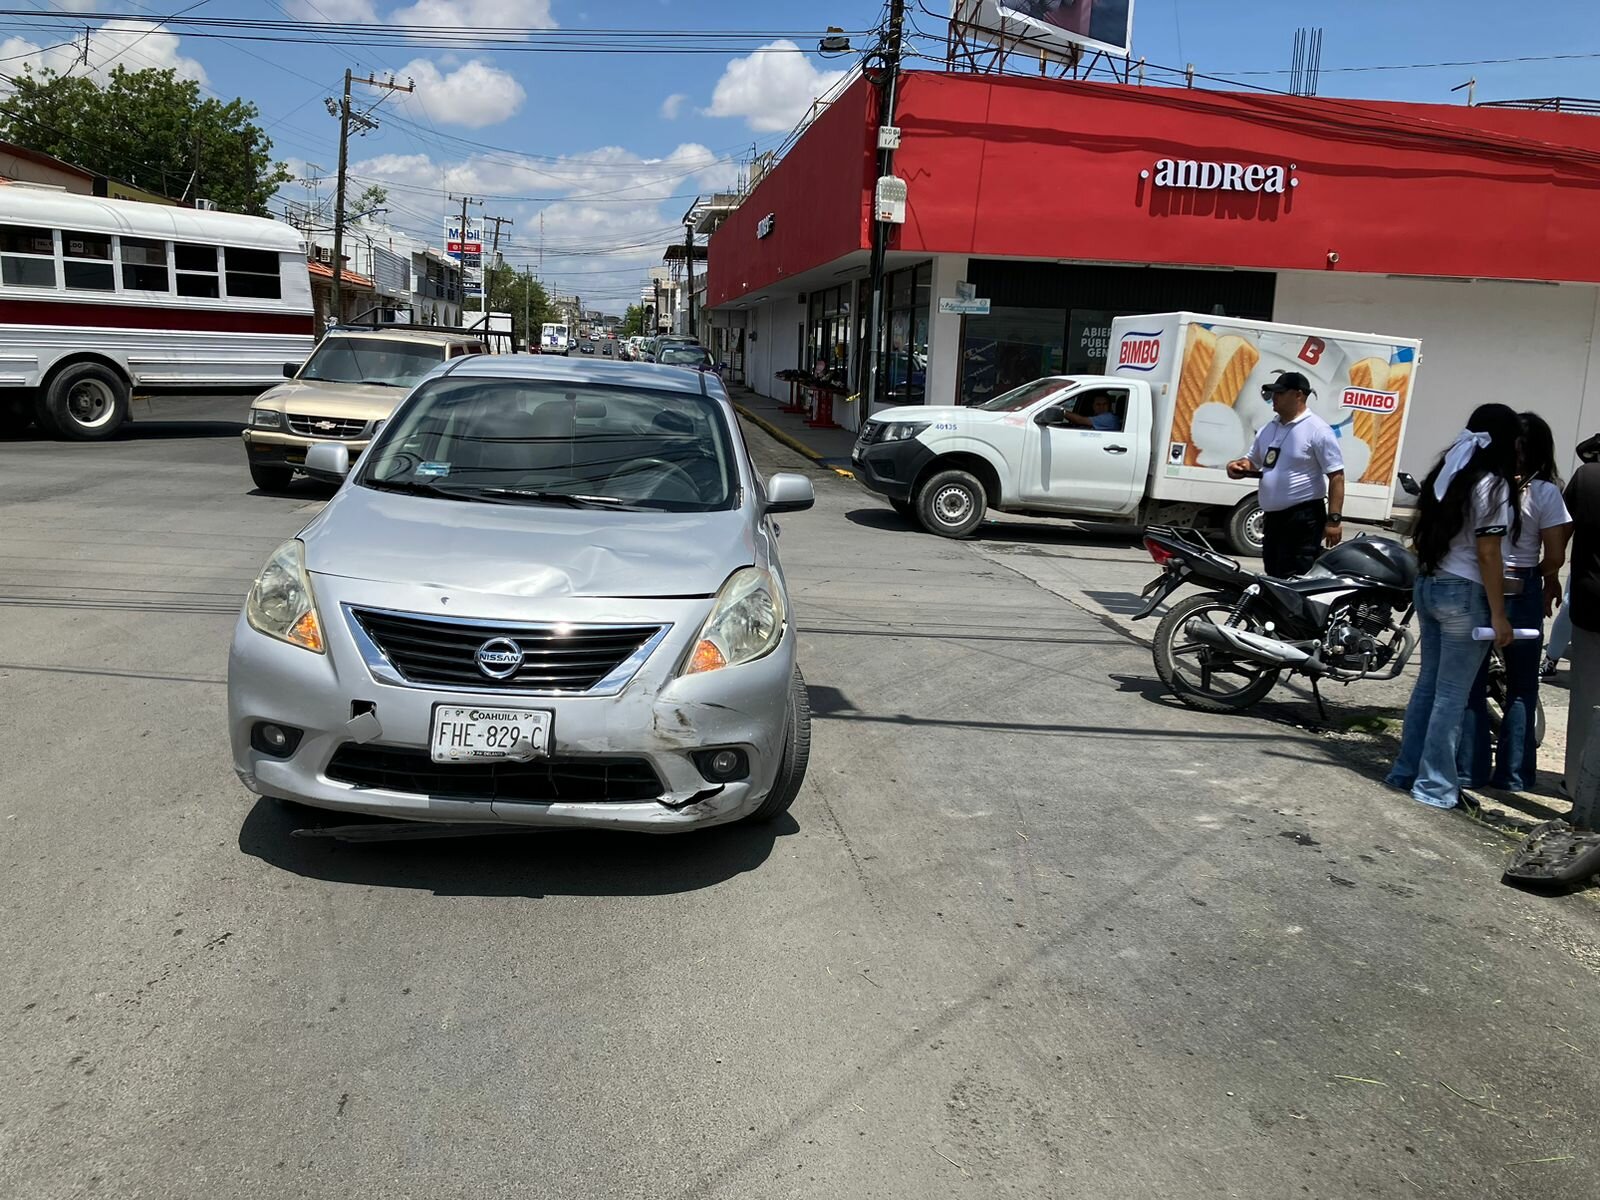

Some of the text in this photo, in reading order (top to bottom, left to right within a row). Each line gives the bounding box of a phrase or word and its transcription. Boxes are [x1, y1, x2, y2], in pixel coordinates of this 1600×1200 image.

[1119, 339, 1160, 364] BIMBO
[1343, 391, 1395, 409] BIMBO
[479, 653, 519, 662] NISSAN
[439, 721, 543, 750] FHE-829-C
